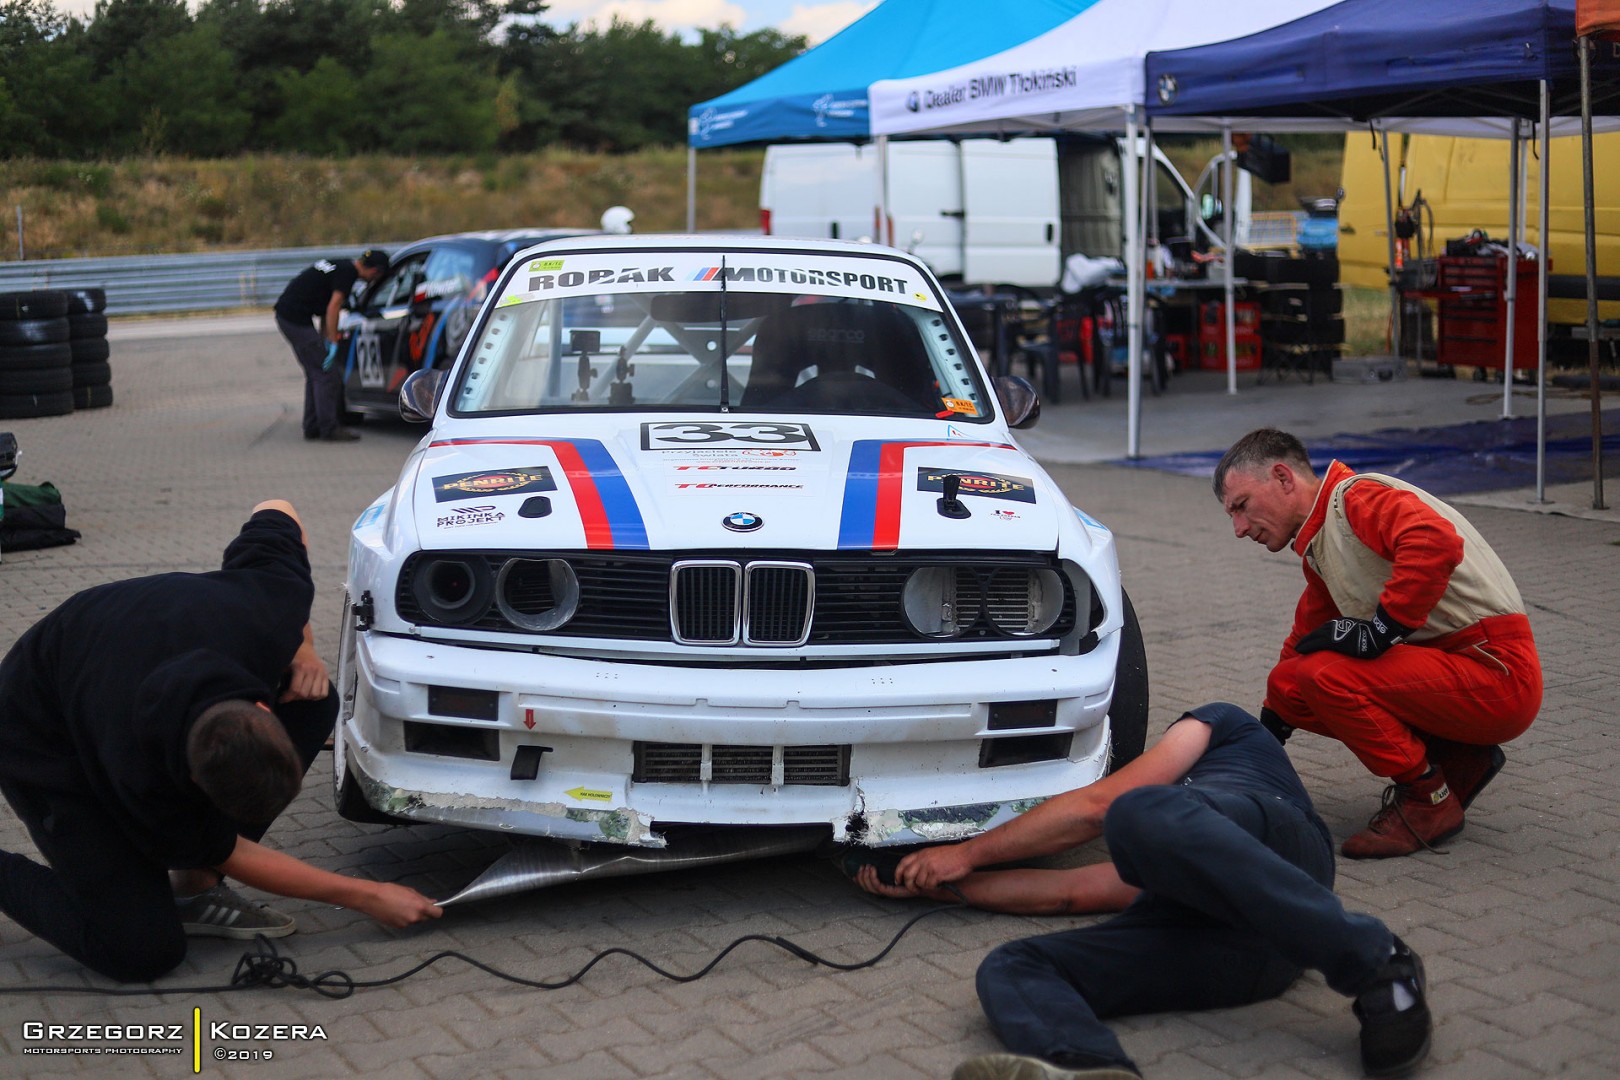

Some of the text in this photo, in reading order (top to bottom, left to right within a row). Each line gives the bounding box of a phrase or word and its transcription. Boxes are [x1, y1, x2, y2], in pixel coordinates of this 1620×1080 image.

[969, 72, 1007, 99] BMW
[712, 267, 908, 295] MOTORSPORT
[652, 423, 809, 444] 33
[443, 475, 543, 490] PENRITE
[927, 475, 1026, 491] PNRITE
[436, 516, 503, 529] PROJEKT
[437, 511, 506, 523] MIKINKA
